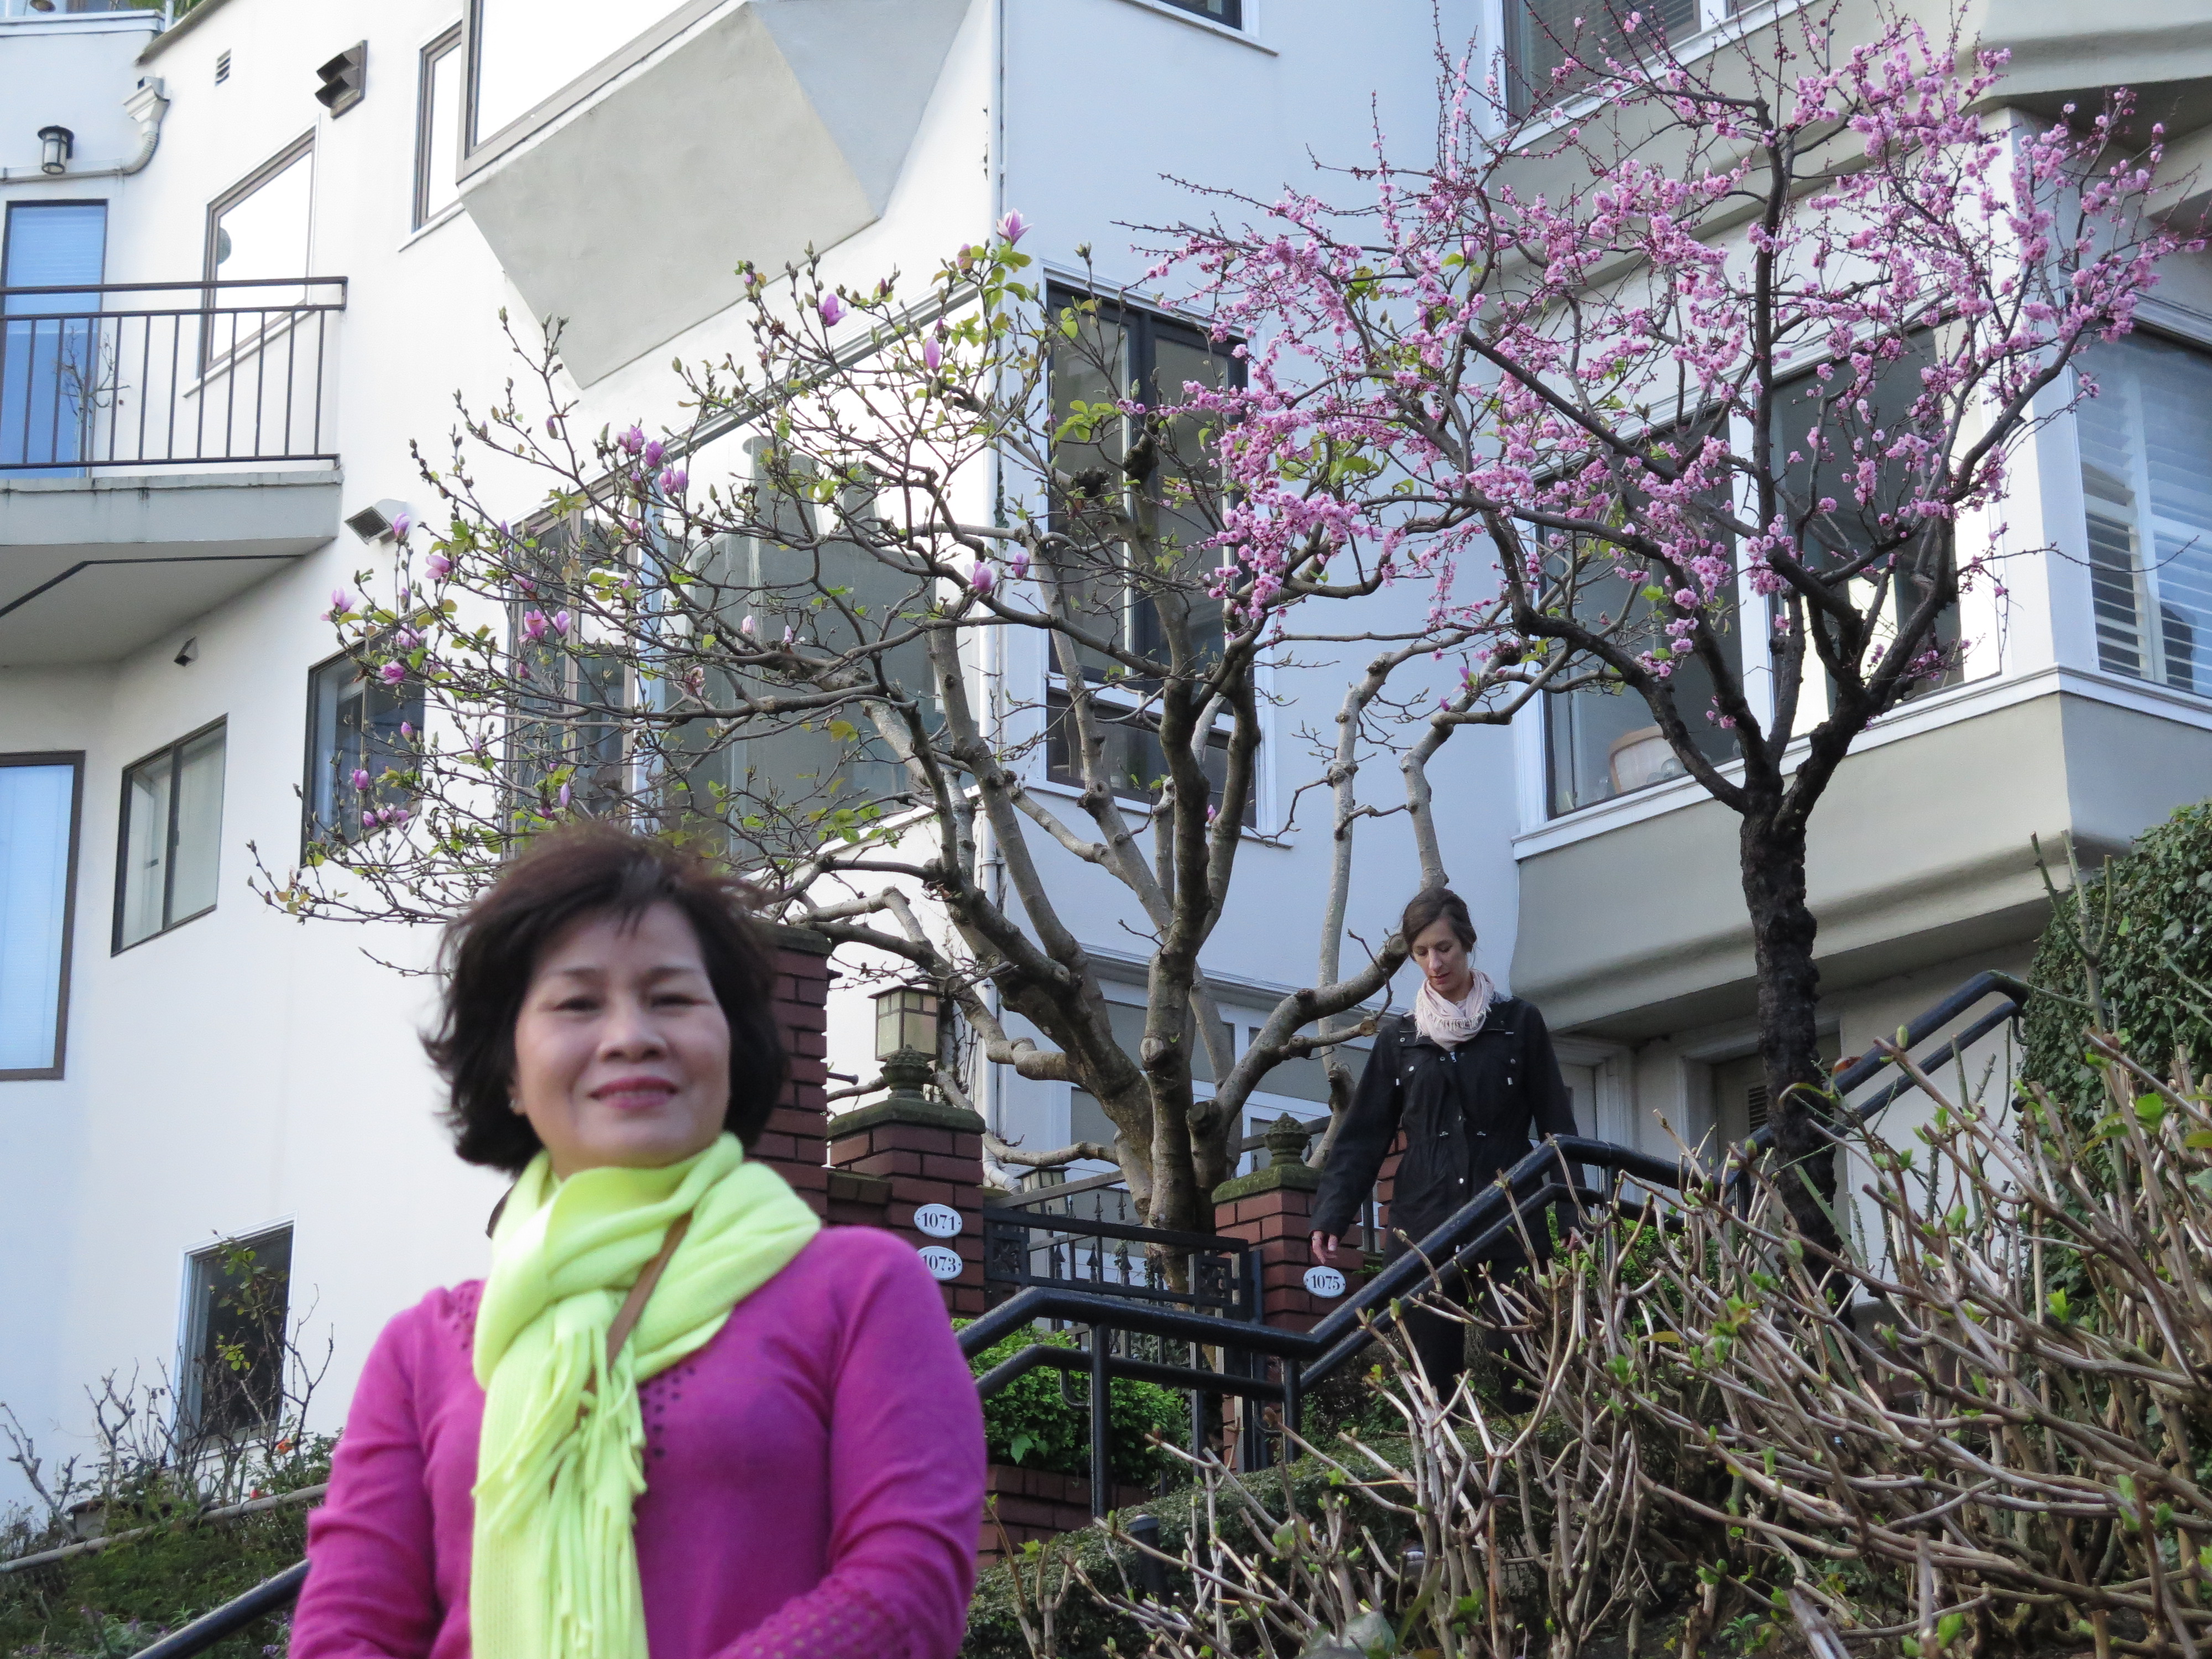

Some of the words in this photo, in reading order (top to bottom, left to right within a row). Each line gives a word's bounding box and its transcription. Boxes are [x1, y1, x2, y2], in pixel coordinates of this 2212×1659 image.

[921, 1212, 955, 1230] 1071
[922, 1254, 956, 1272] 1073
[1311, 1274, 1340, 1290] 1075
